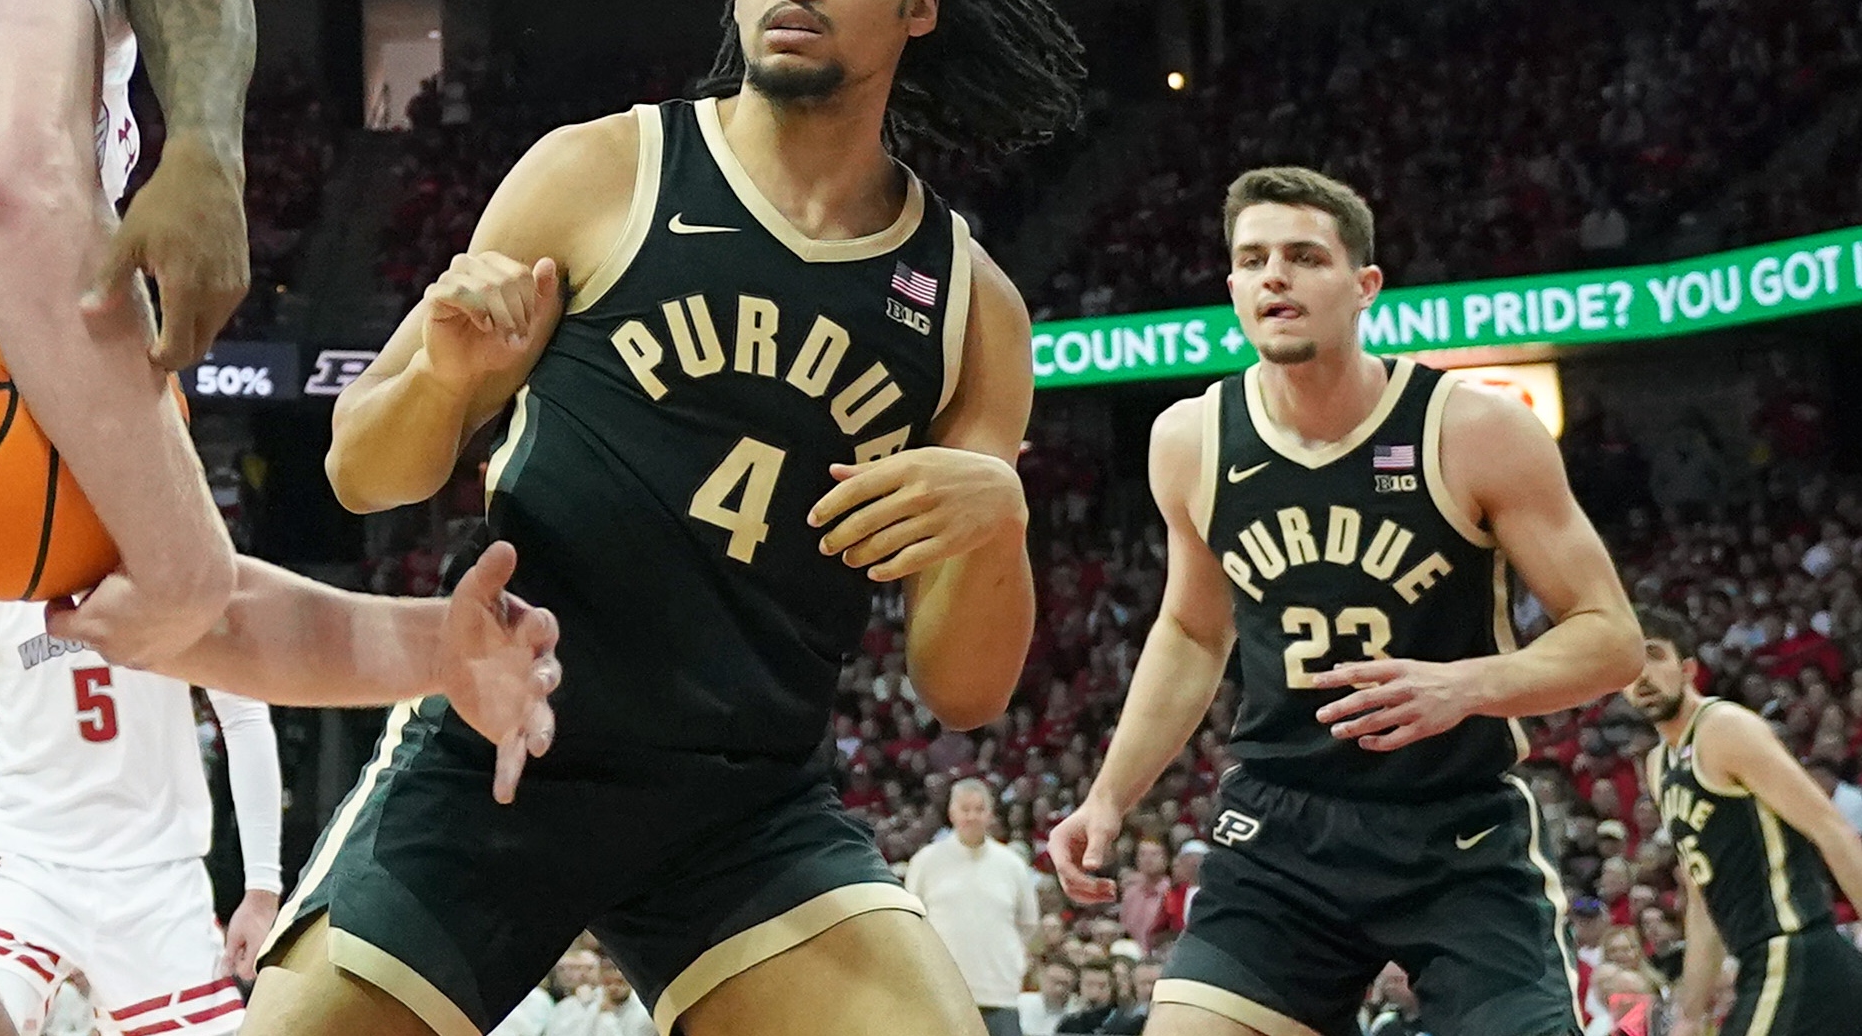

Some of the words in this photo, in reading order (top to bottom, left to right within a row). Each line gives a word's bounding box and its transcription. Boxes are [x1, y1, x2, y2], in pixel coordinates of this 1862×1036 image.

[1464, 280, 1635, 339] PRIDE?
[1646, 264, 1742, 324] YOU
[1749, 245, 1843, 307] GOT
[196, 365, 272, 397] 50%
[688, 436, 787, 564] 4
[1223, 505, 1454, 604] PURDUE
[1281, 606, 1392, 690] 23
[71, 666, 119, 744] 5
[1677, 835, 1715, 884] 5
